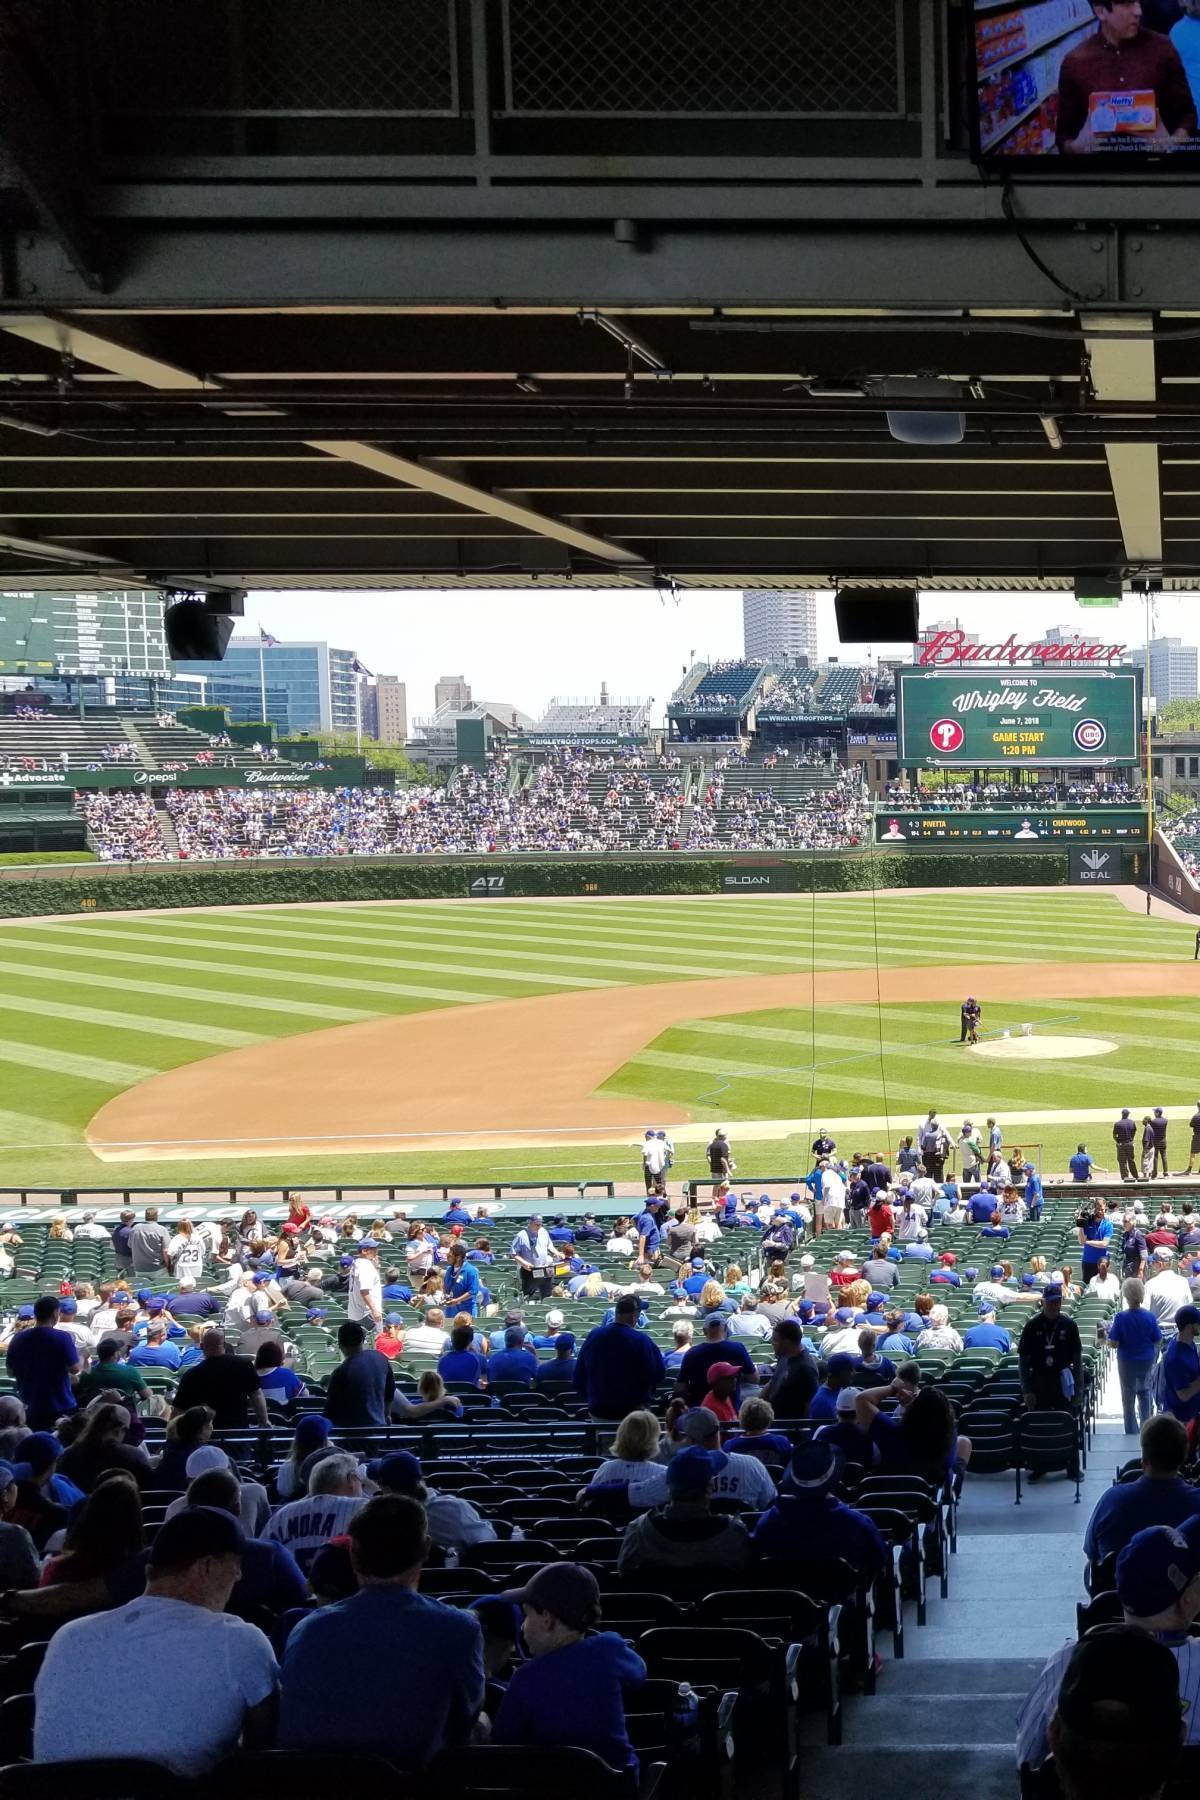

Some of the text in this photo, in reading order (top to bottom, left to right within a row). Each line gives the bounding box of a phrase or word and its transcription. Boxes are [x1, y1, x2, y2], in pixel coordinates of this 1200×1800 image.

[917, 630, 1128, 664] Budweiser
[952, 688, 1087, 712] Wrigley Field
[1000, 717, 1040, 726] June 7, 2018
[993, 732, 1045, 742] GAME START
[1002, 746, 1036, 755] 1:20 PM
[14, 774, 65, 782] Advocate
[149, 773, 177, 783] pepsi
[244, 771, 310, 782] Budweiser
[472, 877, 504, 887] ATI
[724, 876, 770, 885] SLOAN
[181, 1250, 199, 1262] 23
